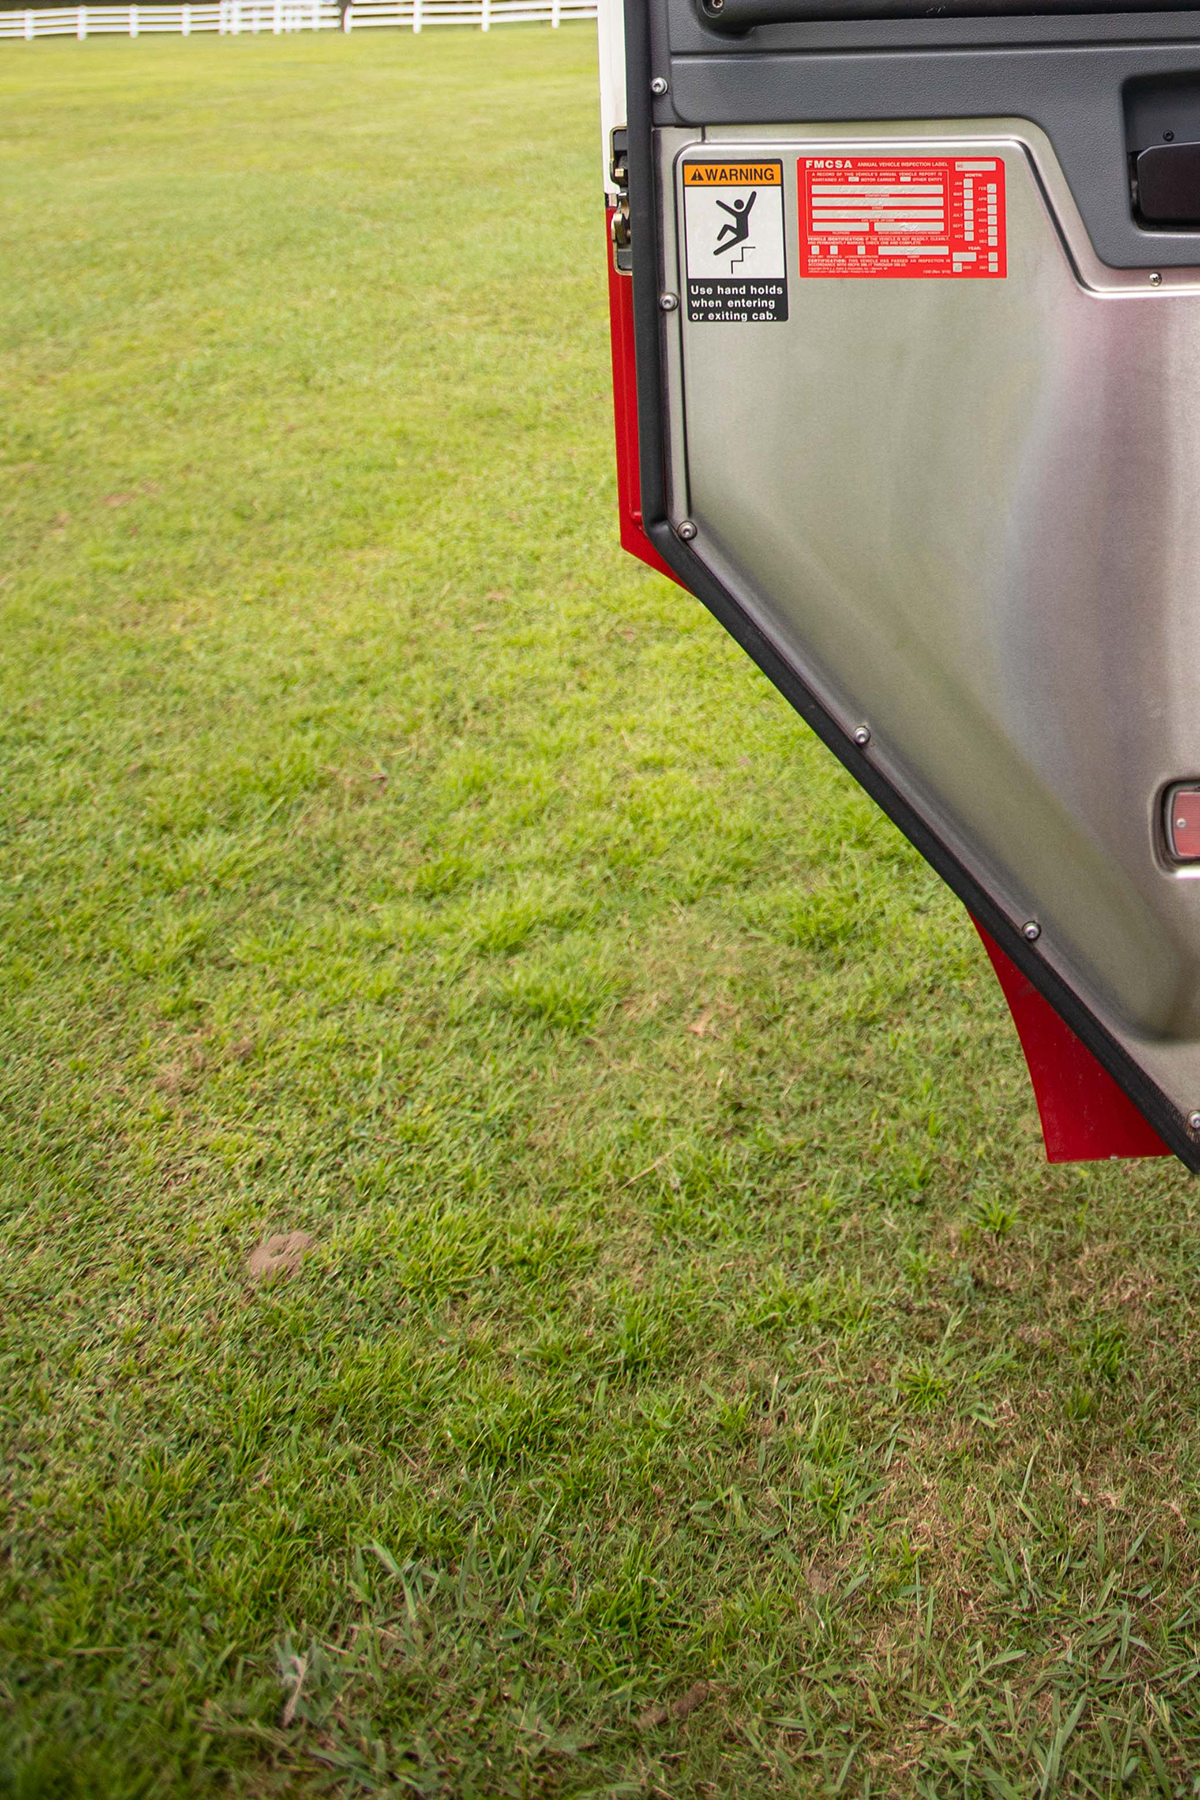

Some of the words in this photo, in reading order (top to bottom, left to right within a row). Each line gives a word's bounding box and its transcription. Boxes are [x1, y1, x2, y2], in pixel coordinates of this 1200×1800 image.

[806, 159, 853, 169] FMCSA
[705, 168, 775, 181] WARNING
[690, 285, 713, 295] Use
[717, 285, 746, 295] hand
[750, 285, 783, 295] holds
[691, 299, 722, 308] when
[727, 298, 776, 309] entering
[708, 311, 748, 322] exiting
[752, 311, 777, 321] cab.
